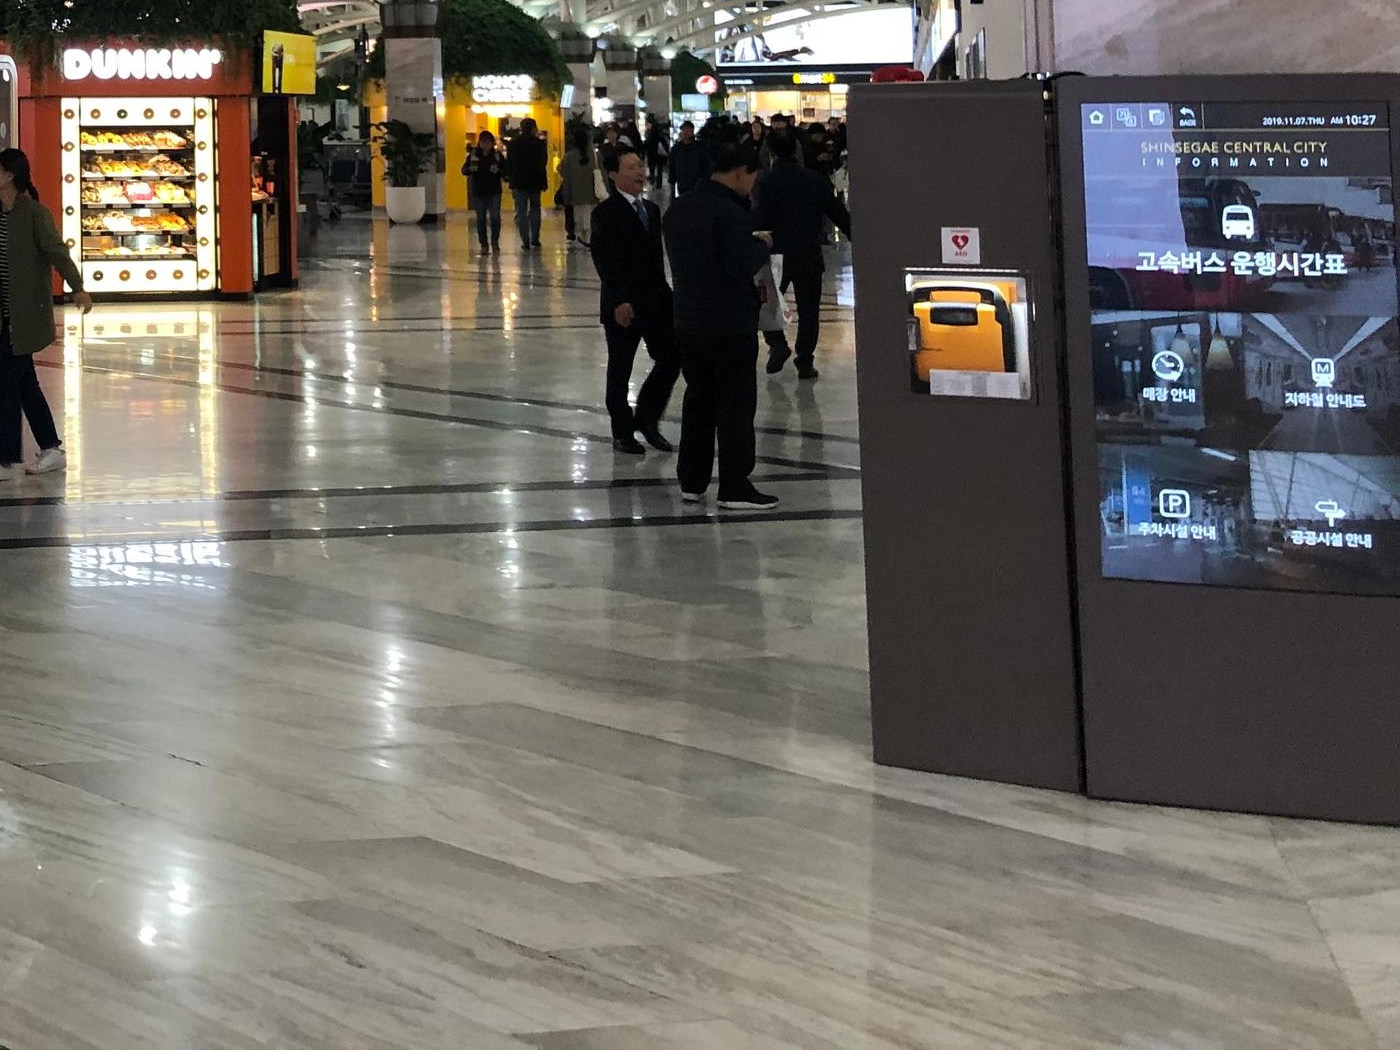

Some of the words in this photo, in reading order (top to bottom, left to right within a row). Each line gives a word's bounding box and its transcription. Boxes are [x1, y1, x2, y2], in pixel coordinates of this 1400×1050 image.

[1330, 117, 1343, 125] AM
[1345, 115, 1376, 126] 10:27
[1140, 141, 1219, 153] SHINSEGAE
[1224, 141, 1290, 153] CENTRAL
[1293, 141, 1328, 153] CITY
[1142, 157, 1328, 167] INFORMATION
[1136, 251, 1227, 275] 고속버스
[1230, 251, 1348, 277] 운행시간표
[1171, 387, 1196, 403] 안내
[1138, 522, 1188, 538] 주차시설
[1190, 525, 1217, 540] 안내
[1291, 530, 1342, 547] 공공시설
[1345, 531, 1372, 548] 안내
